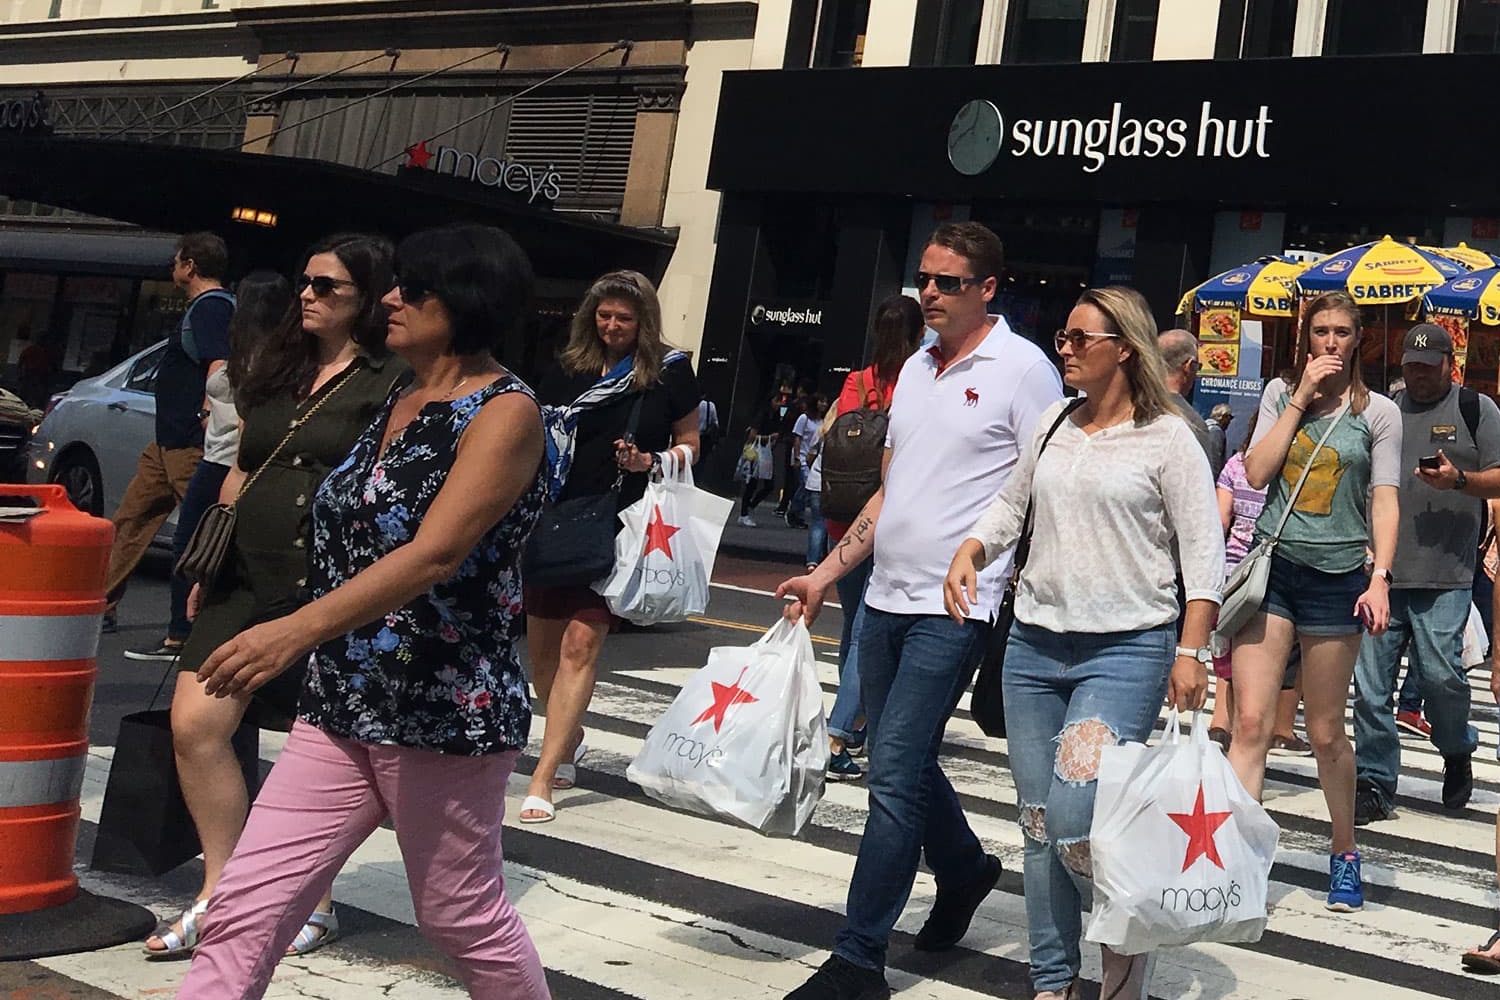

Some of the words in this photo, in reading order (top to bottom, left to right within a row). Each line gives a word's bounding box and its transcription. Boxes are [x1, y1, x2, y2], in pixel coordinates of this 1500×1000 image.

[1011, 101, 1188, 173] sunglass
[1197, 100, 1273, 158] hut
[765, 307, 805, 326] sunglass
[805, 308, 822, 325] hut
